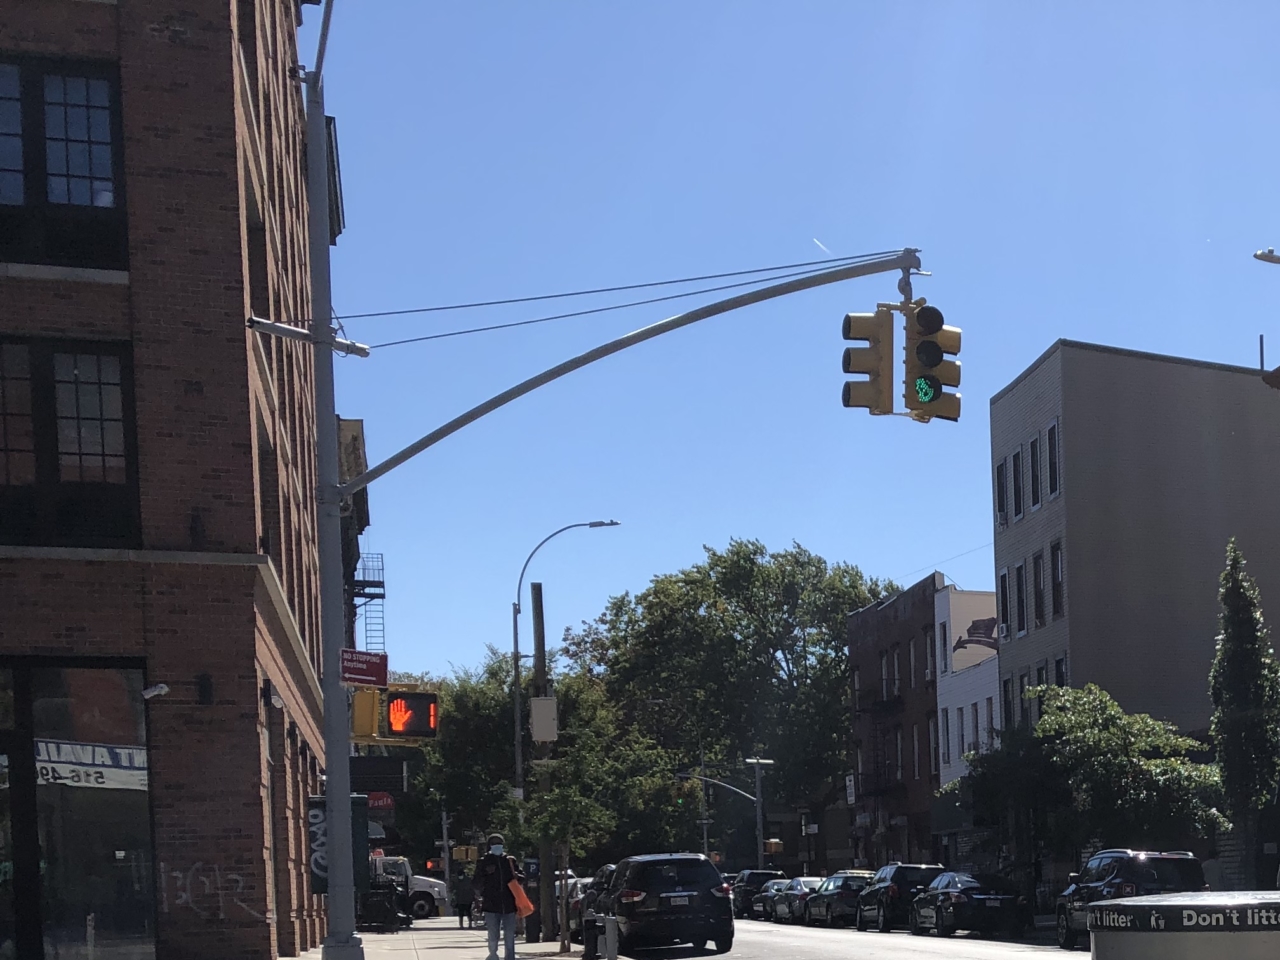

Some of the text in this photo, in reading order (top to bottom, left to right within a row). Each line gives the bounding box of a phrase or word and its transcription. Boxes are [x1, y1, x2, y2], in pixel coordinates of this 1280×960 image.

[343, 652, 381, 664] NO STOPPING
[343, 660, 367, 670] Anytime
[1103, 910, 1134, 927] litter
[1182, 910, 1239, 927] Don't
